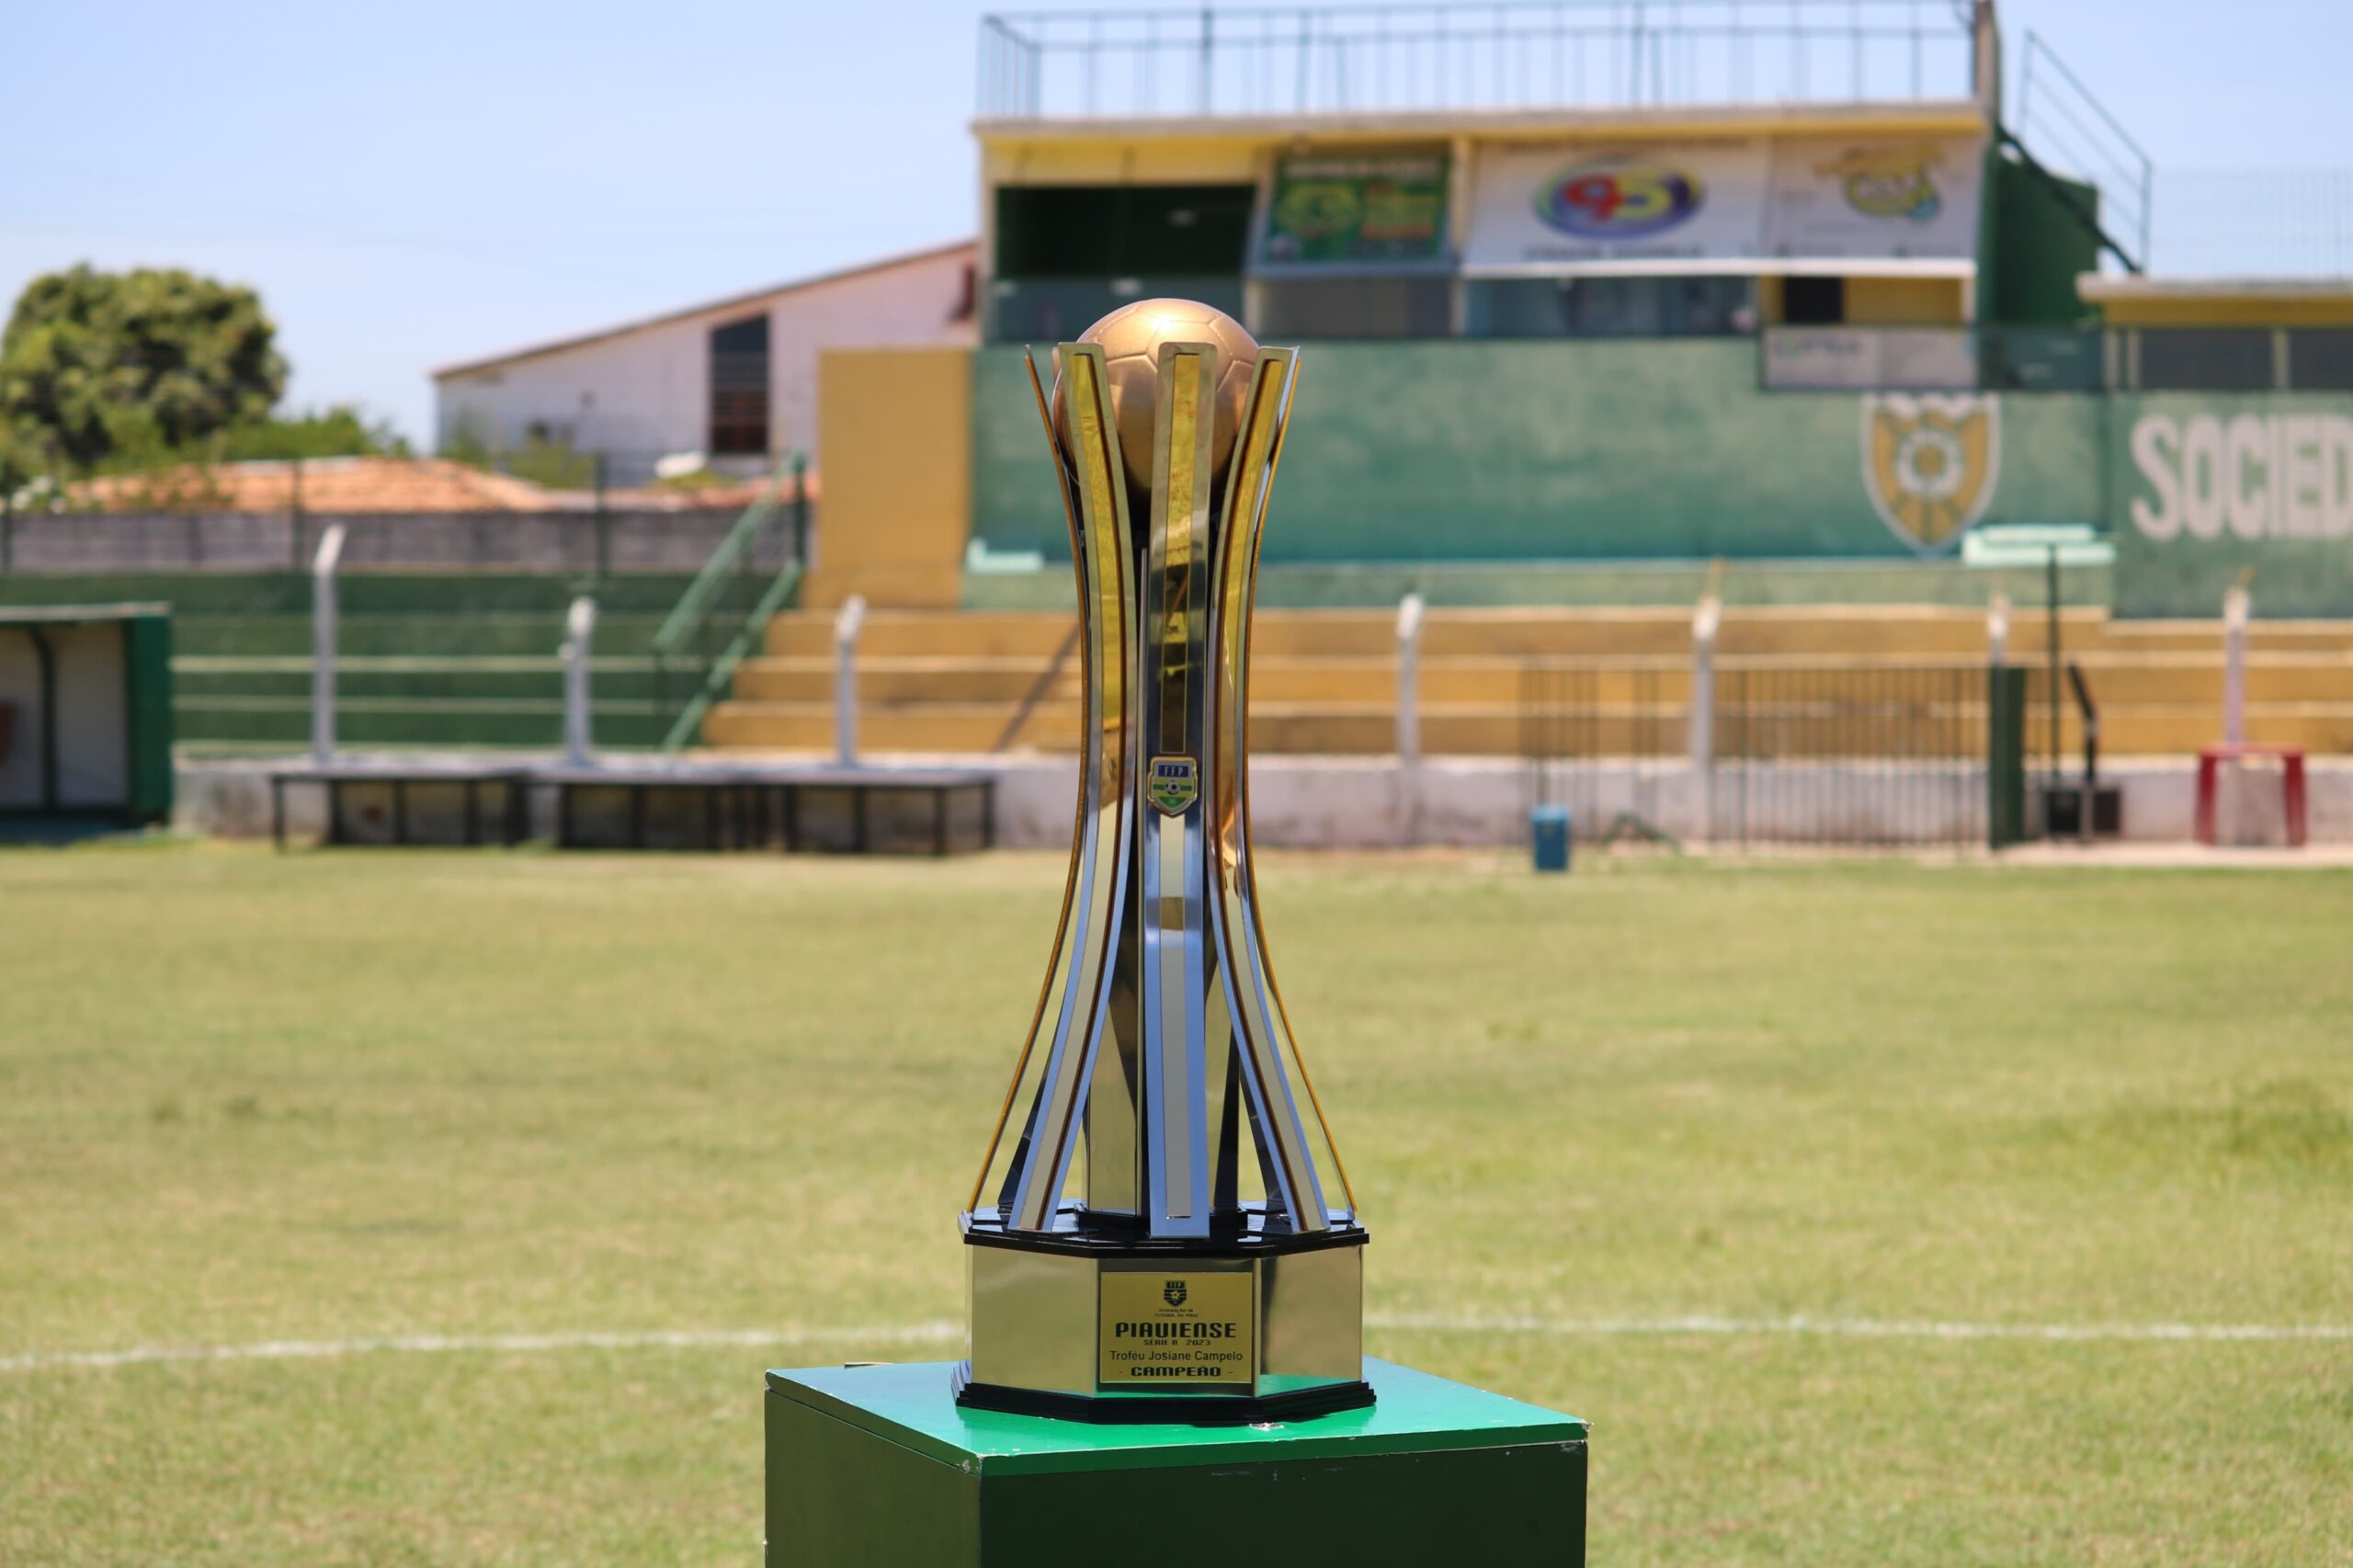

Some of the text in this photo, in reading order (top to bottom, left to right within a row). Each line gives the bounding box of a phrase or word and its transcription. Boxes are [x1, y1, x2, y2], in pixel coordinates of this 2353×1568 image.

[2129, 414, 2353, 542] SOCIED
[1115, 1322, 1236, 1338] PIAUIENSE
[1148, 1350, 1191, 1361] Josiane
[1194, 1350, 1244, 1363] Campelo
